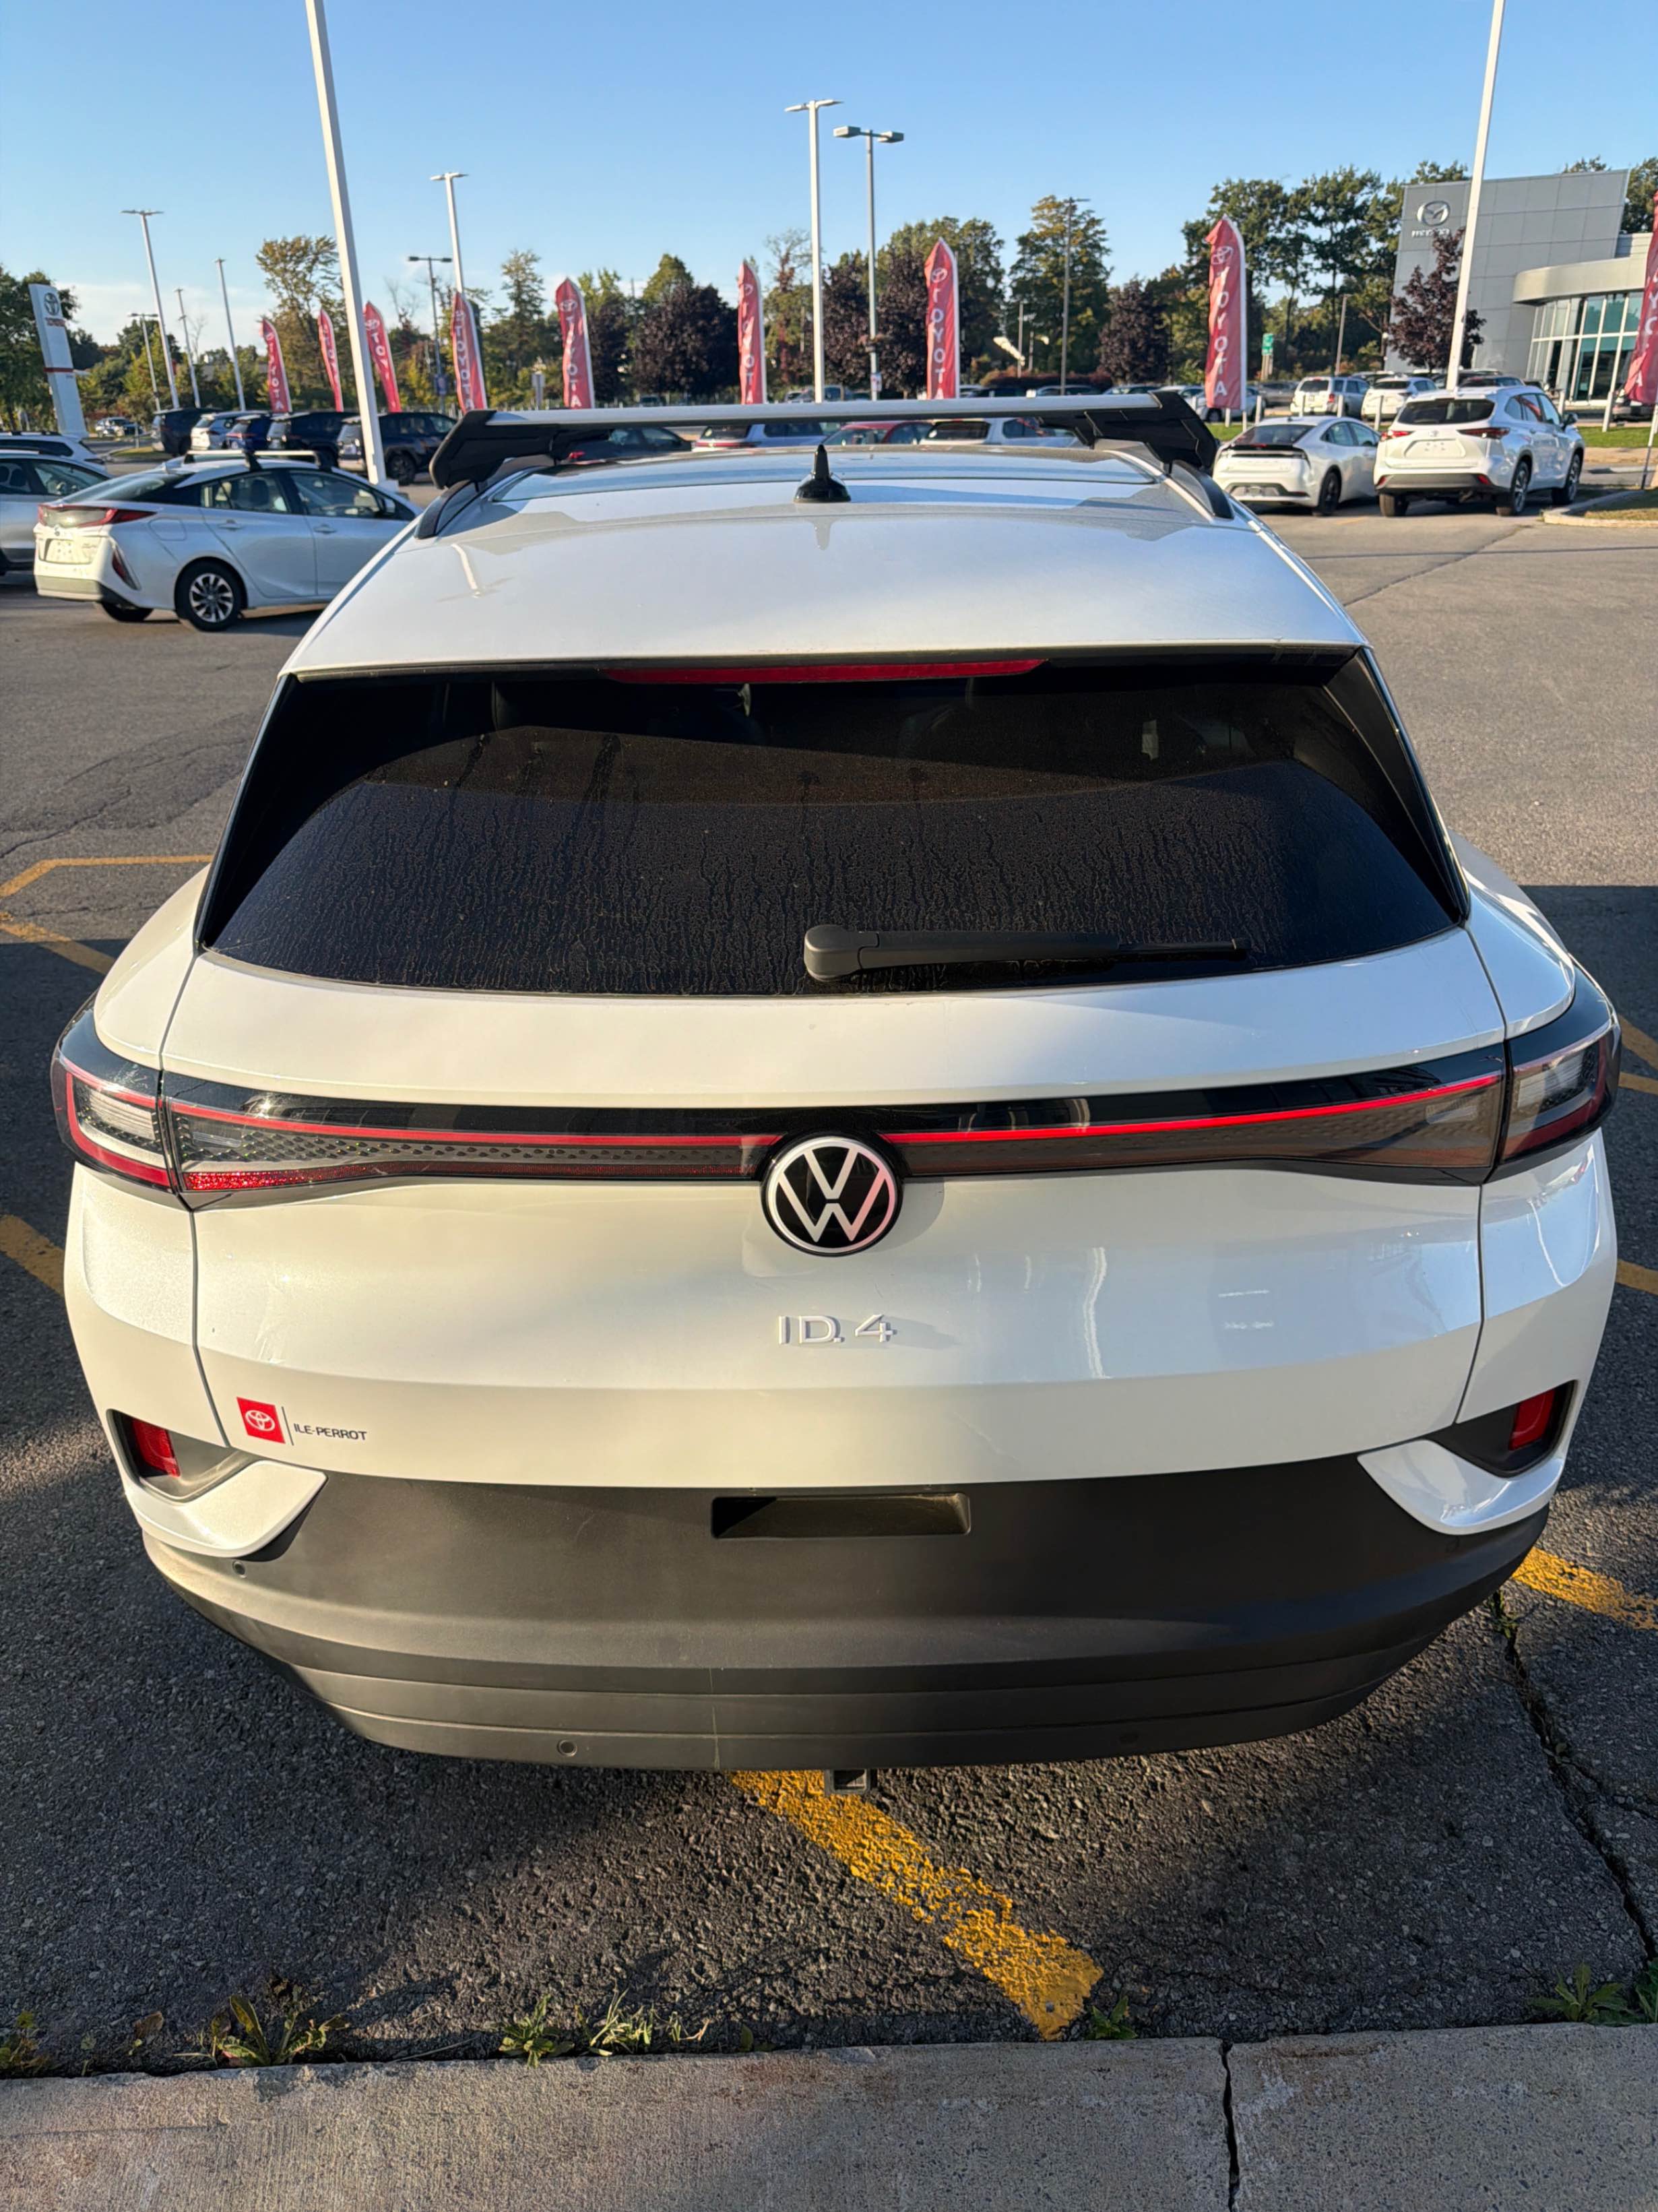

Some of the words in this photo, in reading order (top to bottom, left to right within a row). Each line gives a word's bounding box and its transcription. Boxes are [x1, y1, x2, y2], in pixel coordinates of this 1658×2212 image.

[455, 325, 474, 410] TOYOTA
[931, 288, 945, 399] TOYOTA
[294, 1423, 367, 1441] ILE-PERROT
